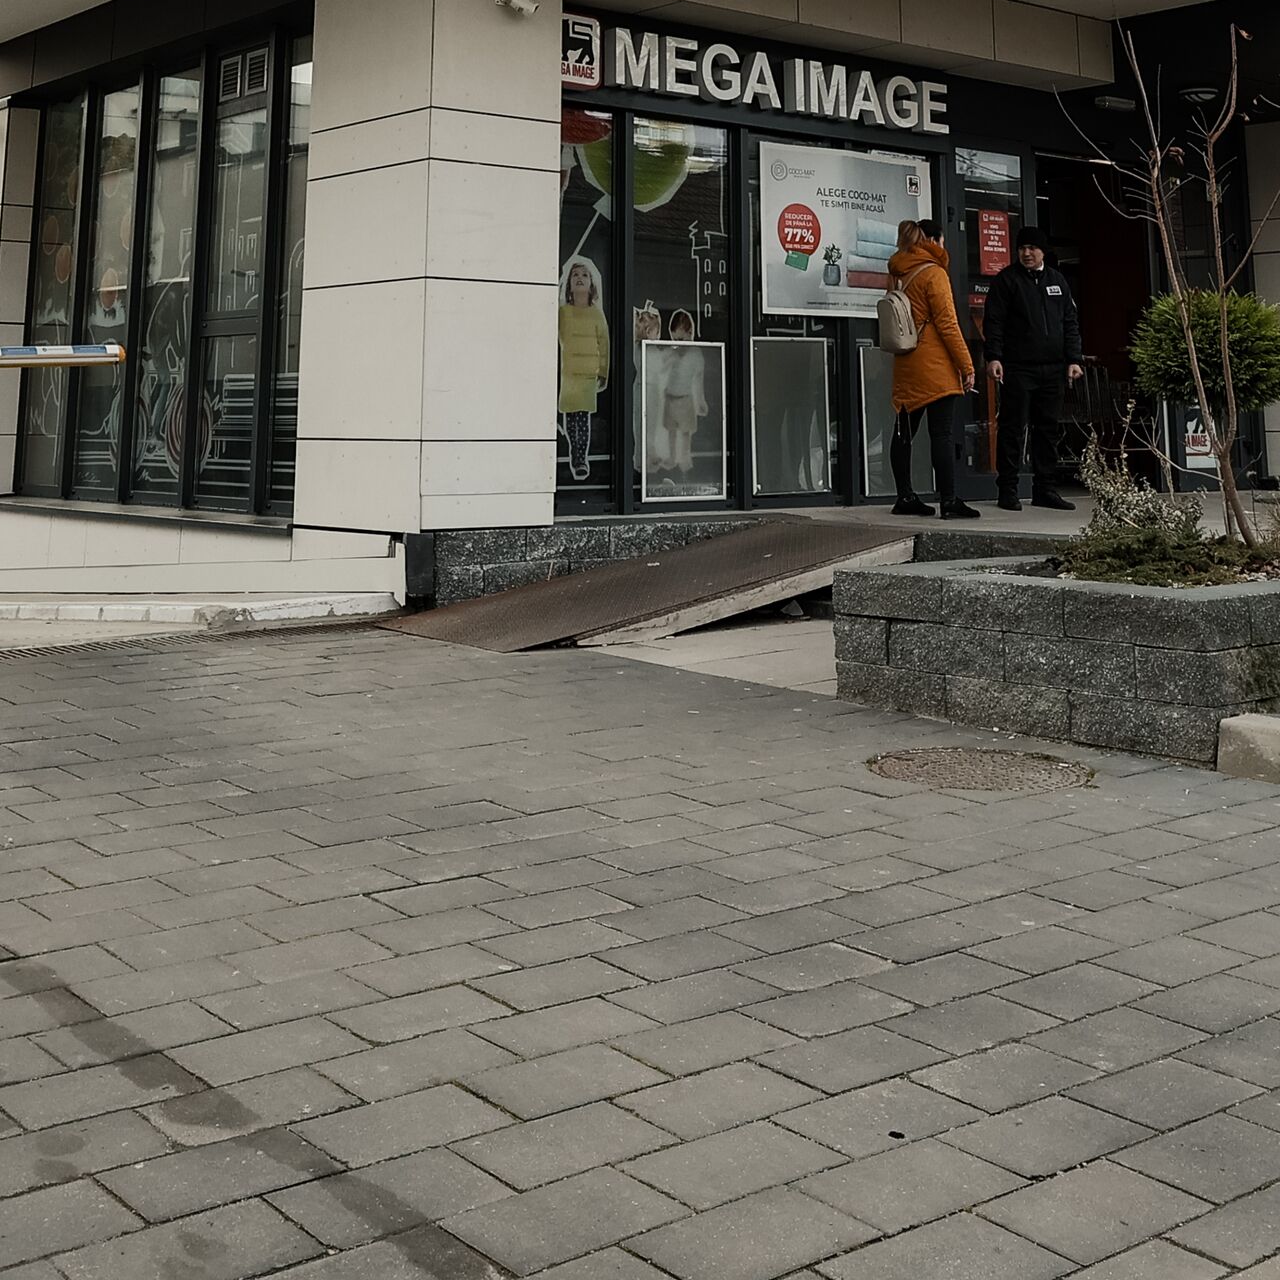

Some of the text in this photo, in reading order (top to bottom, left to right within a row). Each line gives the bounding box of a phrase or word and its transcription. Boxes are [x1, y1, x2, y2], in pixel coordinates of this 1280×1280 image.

[561, 62, 595, 80] GA IMAGE
[614, 26, 950, 135] MEGA IMAGE
[816, 187, 887, 204] ALEGE COCO-MAT
[820, 199, 830, 208] TE
[851, 202, 865, 211] BINE
[784, 212, 813, 221] REDUCERI
[784, 228, 815, 243] 77%
